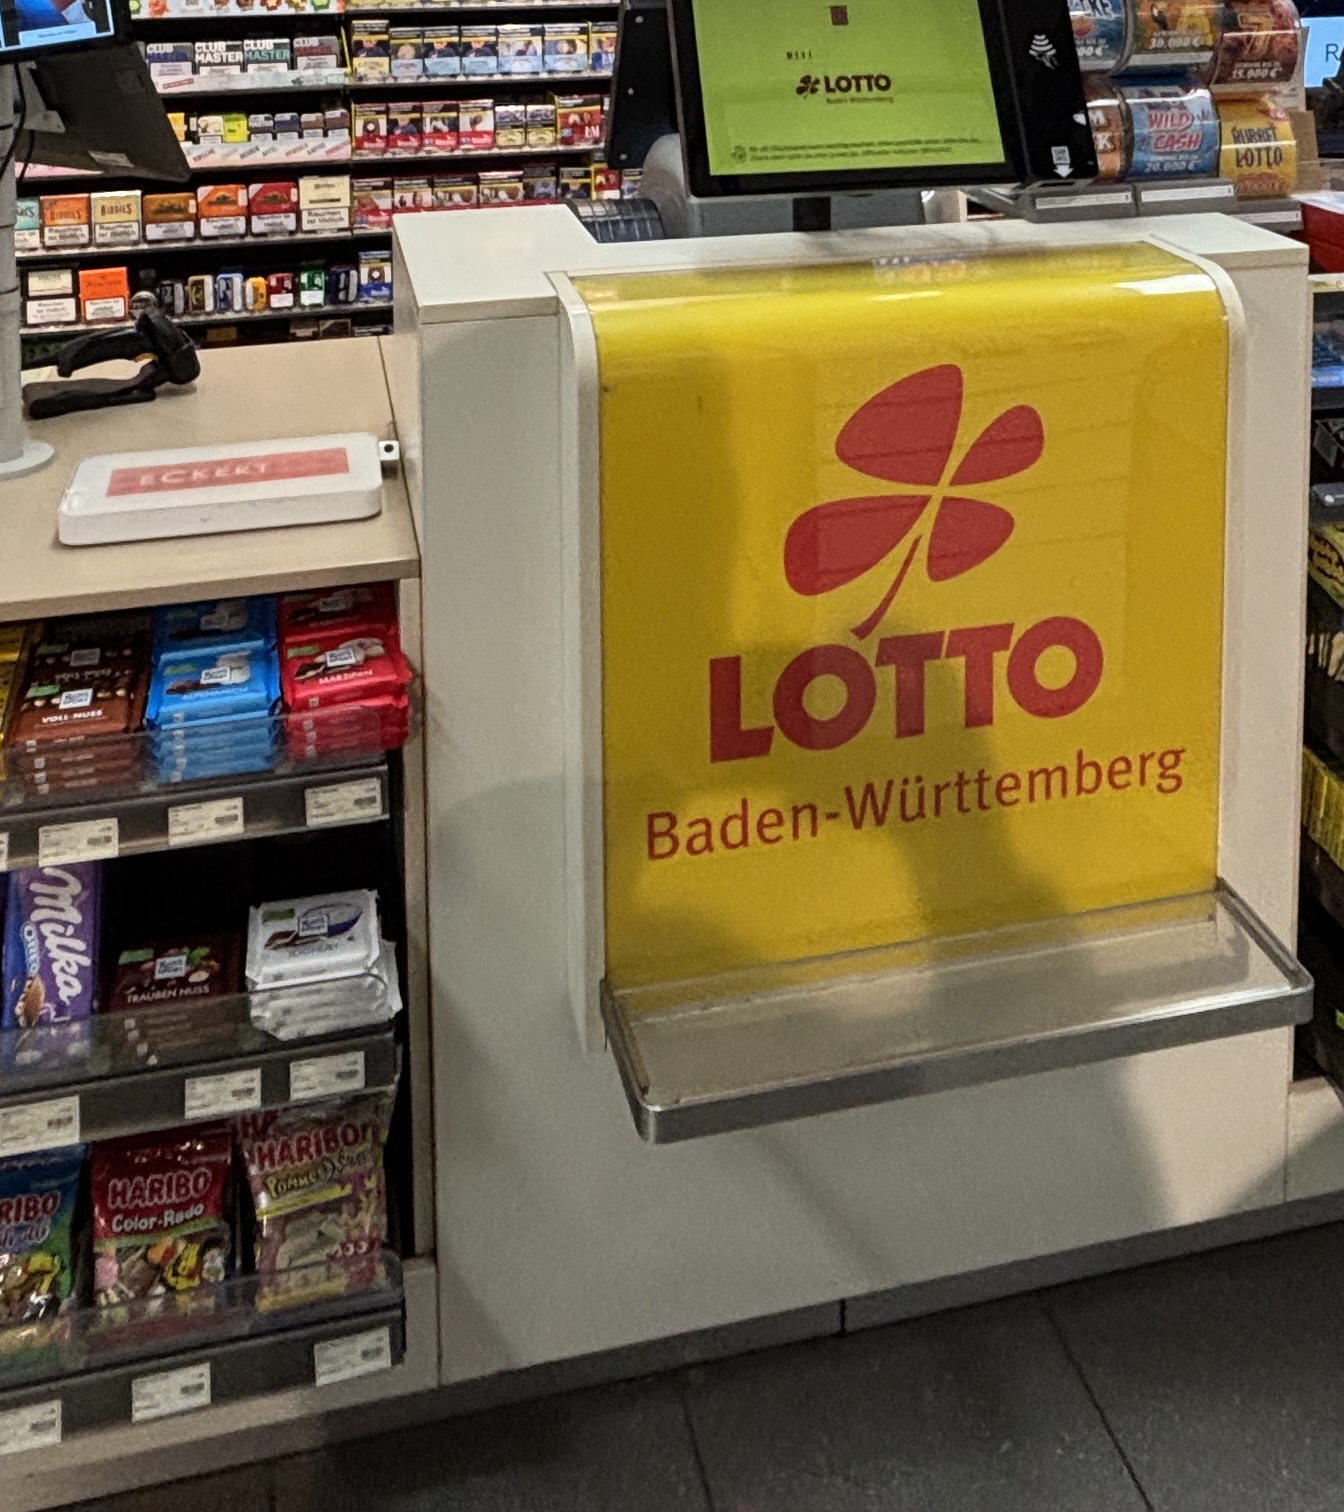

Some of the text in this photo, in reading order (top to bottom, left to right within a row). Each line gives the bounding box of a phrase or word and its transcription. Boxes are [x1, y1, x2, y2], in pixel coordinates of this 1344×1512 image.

[195, 41, 226, 53] CLUB
[244, 39, 274, 51] CLUB
[244, 49, 290, 62] MASTER
[195, 51, 244, 64] MASTER
[824, 73, 892, 94] LOTTO
[1146, 109, 1193, 131] WILD
[1152, 133, 1203, 152] CASH
[1144, 160, 1184, 173] 20.000
[1235, 146, 1284, 168] LOTTO
[100, 203, 133, 217] BIRDIES
[139, 461, 270, 487] ECKERT
[708, 615, 1105, 764] LOTTO
[645, 745, 1187, 862] Baden-Württemberg
[20, 920, 39, 976] OREO
[29, 867, 92, 1007] Milka
[126, 983, 210, 1004] TRAUBEN NUSS
[258, 1122, 364, 1172] HARIBO
[107, 1167, 212, 1210] HARIBO
[111, 1202, 205, 1234] Color-Rado
